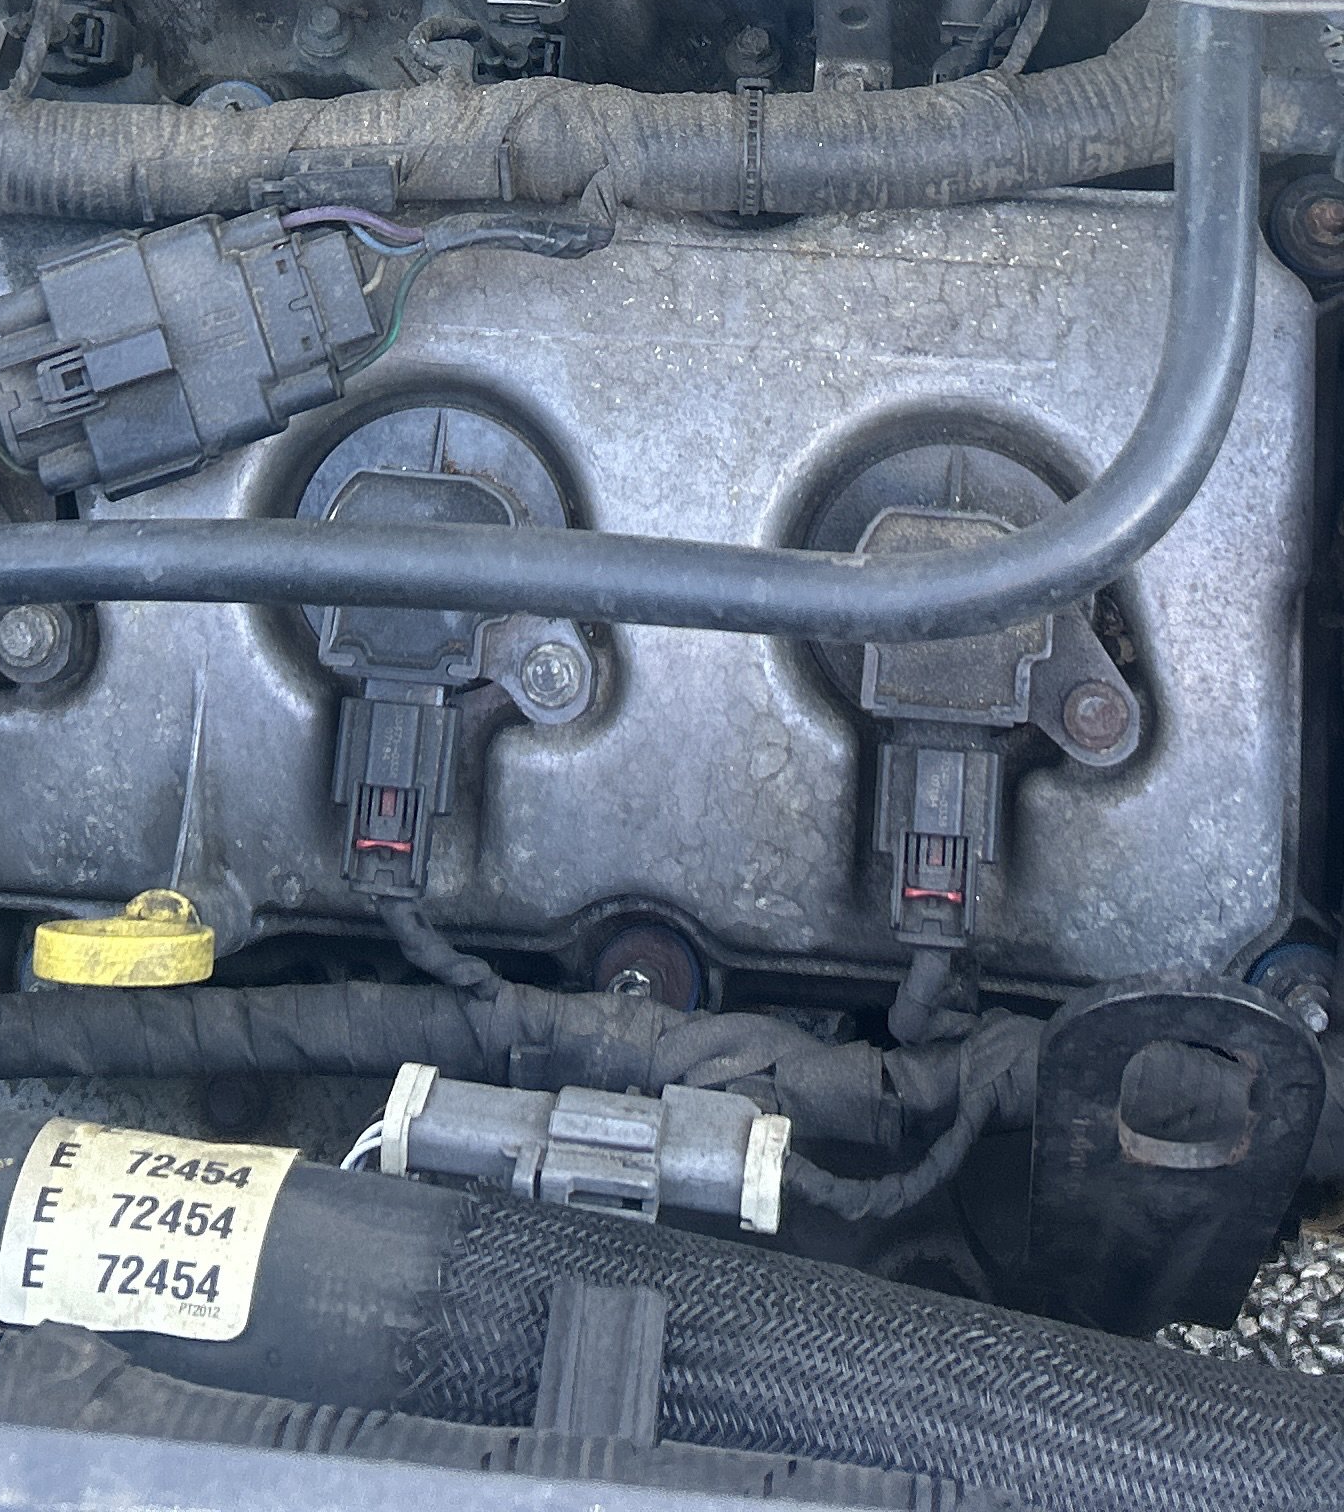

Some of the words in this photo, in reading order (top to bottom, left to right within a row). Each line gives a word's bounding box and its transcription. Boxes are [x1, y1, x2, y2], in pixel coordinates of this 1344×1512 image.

[50, 1142, 81, 1168] E
[125, 1149, 252, 1188] 72454
[33, 1186, 63, 1223] E
[109, 1193, 236, 1239] 72454
[22, 1248, 48, 1288] E
[97, 1253, 221, 1303] 72454
